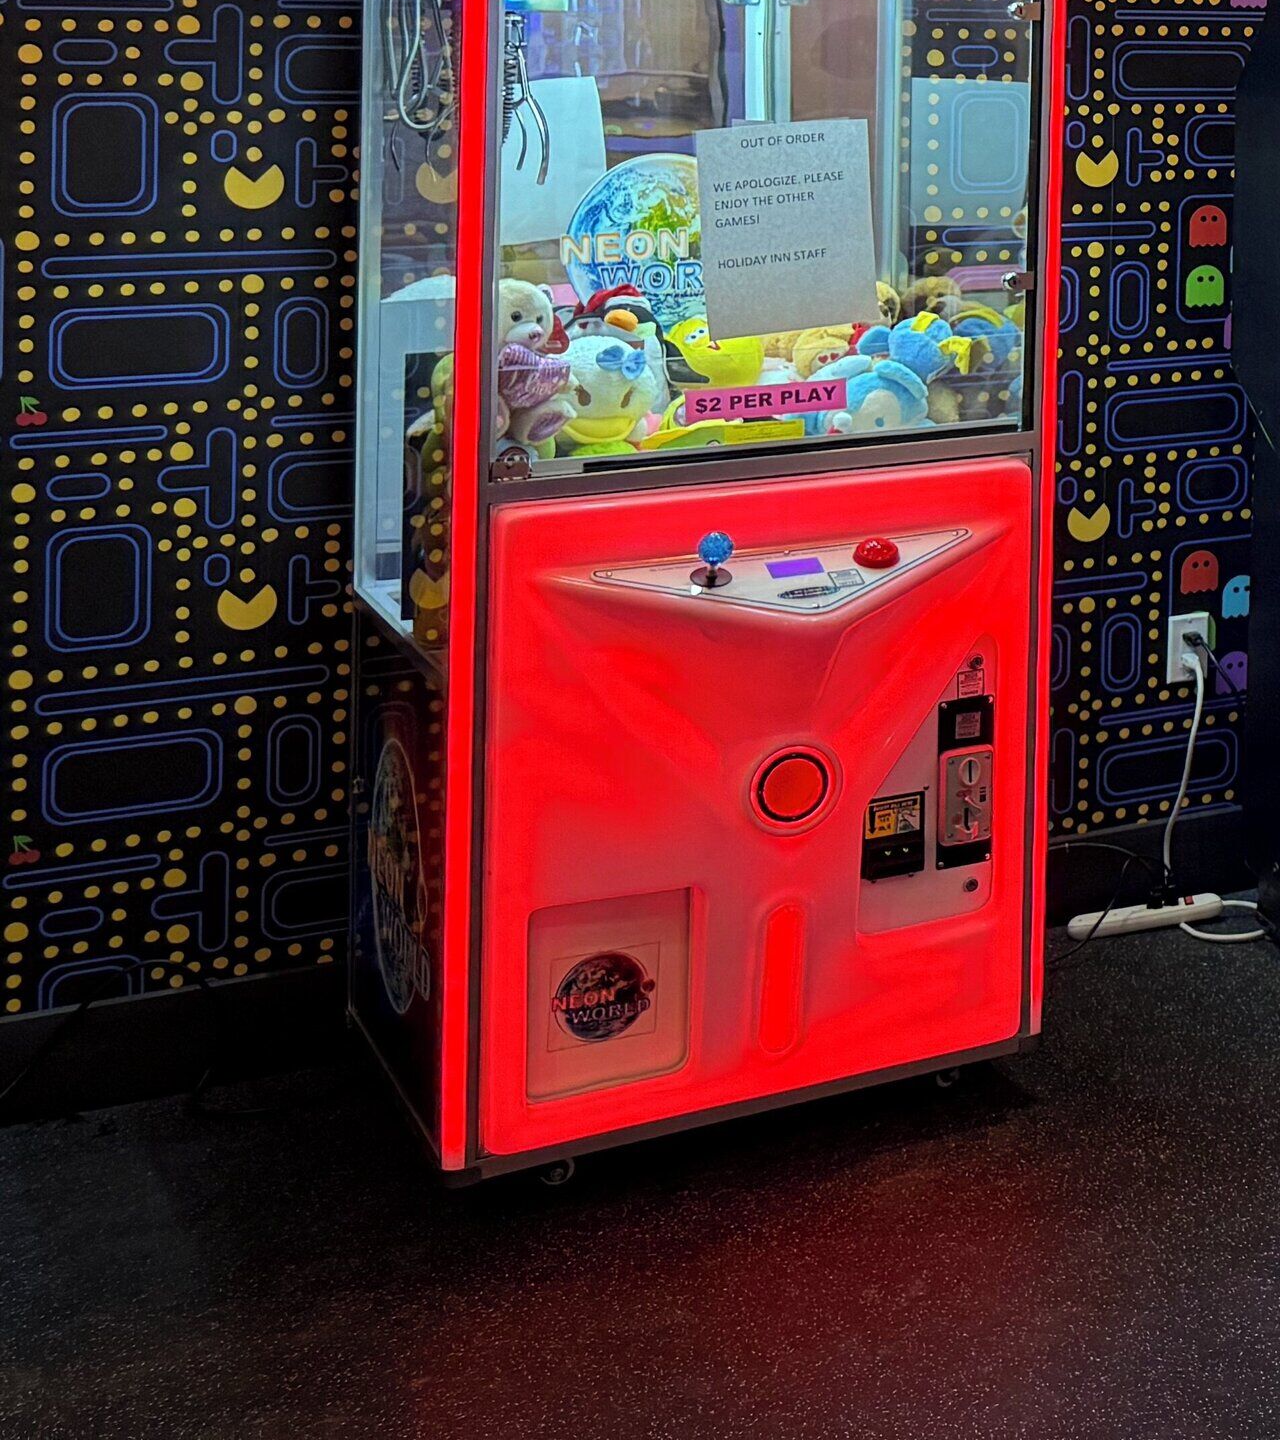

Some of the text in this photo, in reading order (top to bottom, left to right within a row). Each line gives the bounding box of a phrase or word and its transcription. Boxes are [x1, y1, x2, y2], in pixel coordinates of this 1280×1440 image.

[740, 132, 825, 149] OUT OF ORDER
[713, 181, 732, 193] WE
[803, 170, 844, 184] PLEASE
[714, 191, 815, 211] ENJOY THE OTHER
[715, 214, 760, 228] GAMES!
[560, 227, 690, 265] NEON
[718, 248, 827, 269] HOLIDAY INN STAFF
[600, 261, 703, 291] WOR
[695, 385, 838, 415] $2 PER PLAY
[551, 987, 616, 1013] NEON
[571, 996, 651, 1024] WORLD
